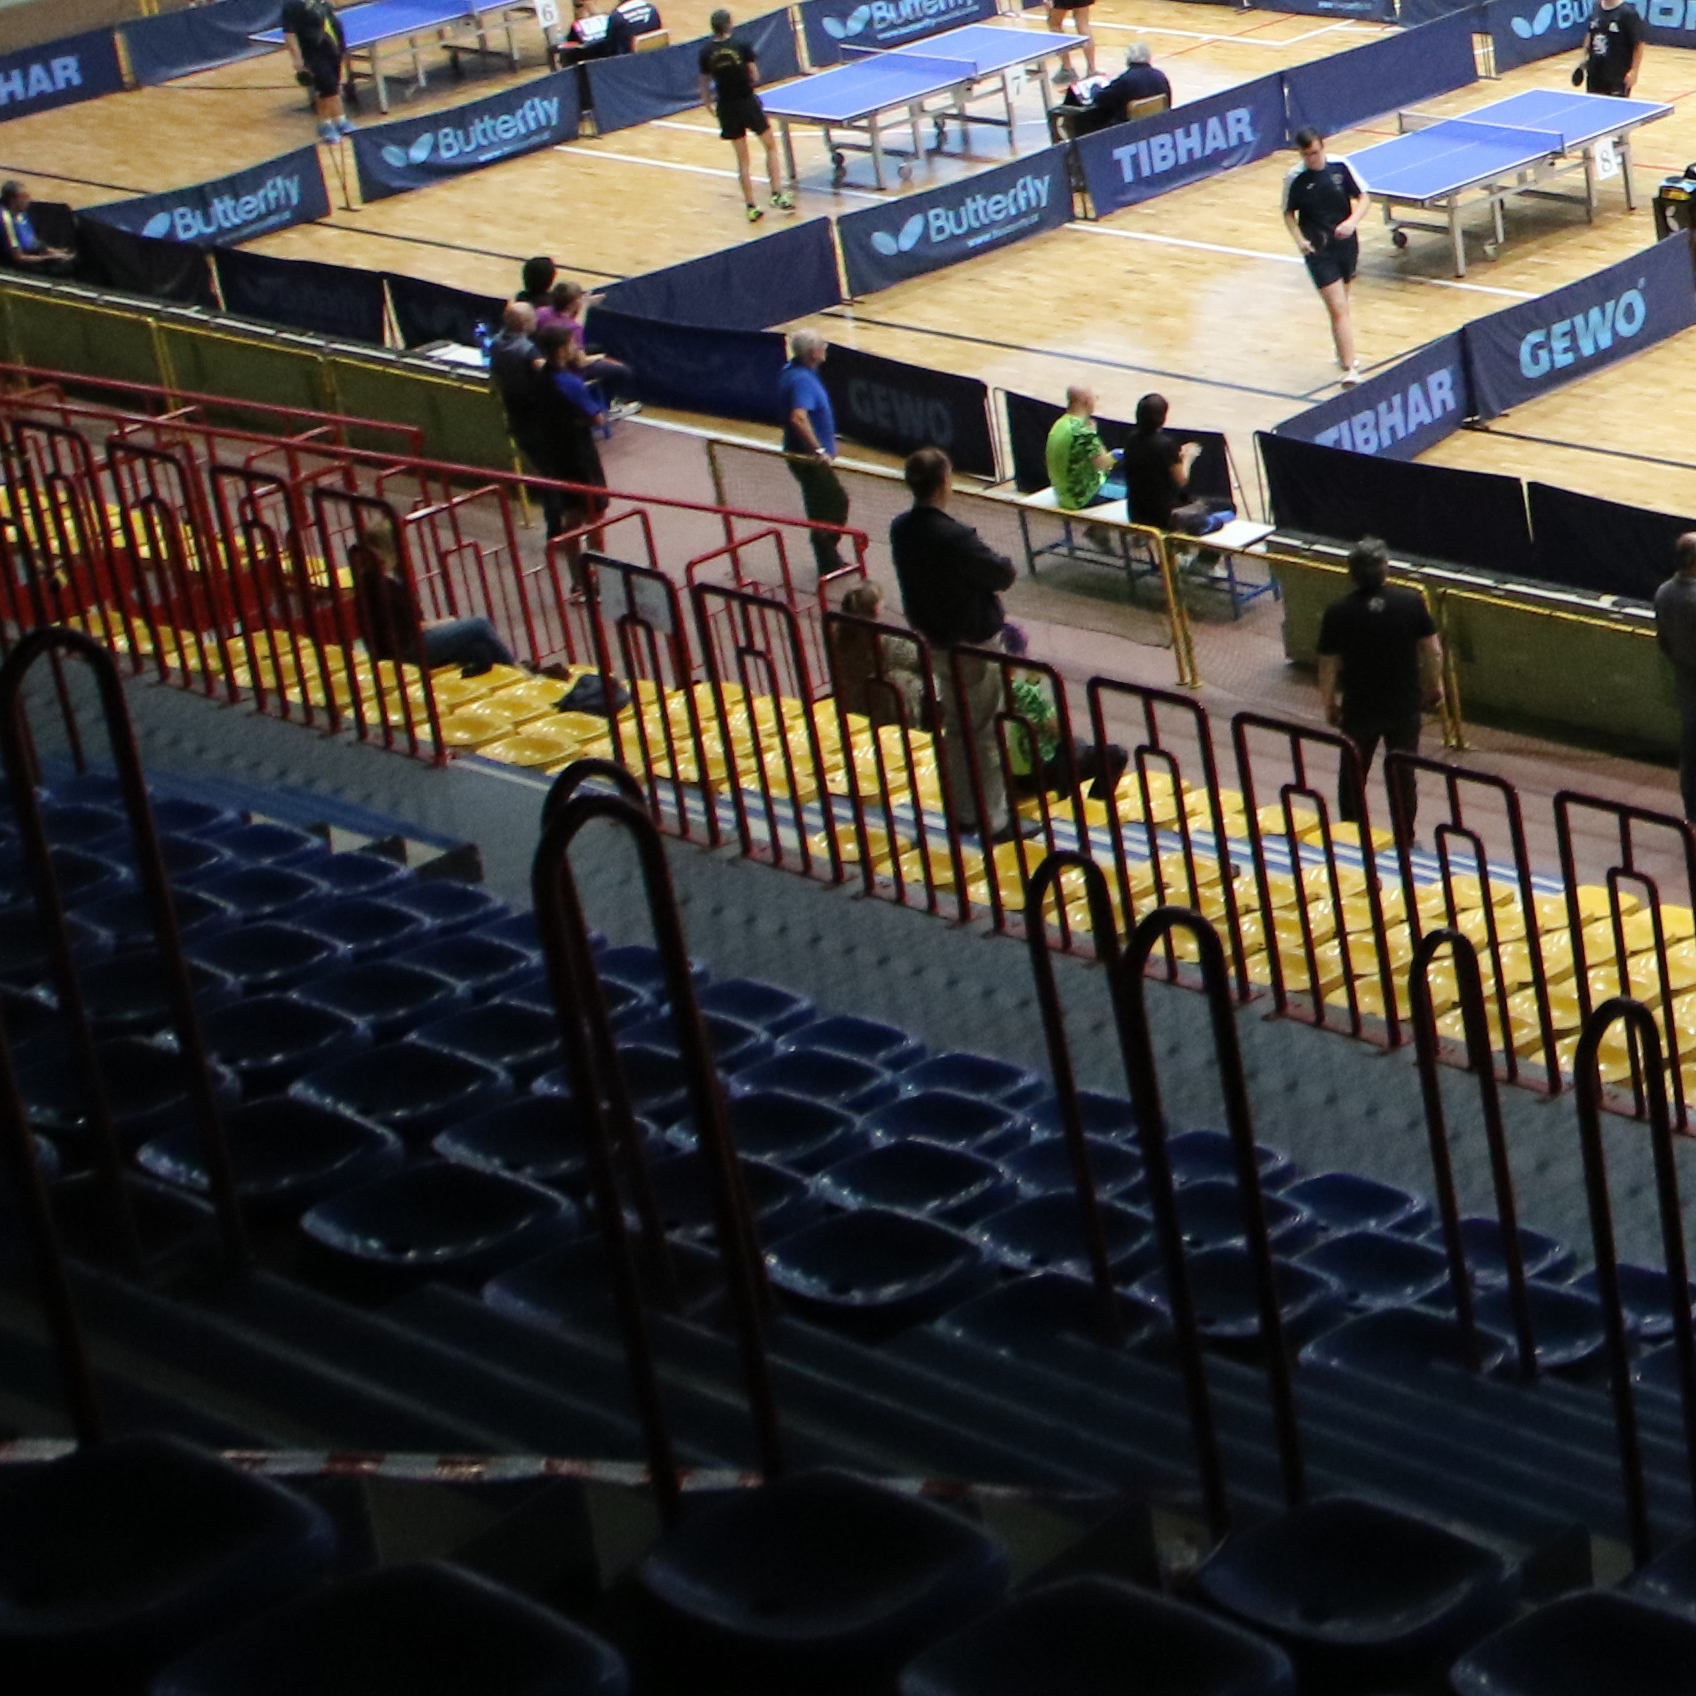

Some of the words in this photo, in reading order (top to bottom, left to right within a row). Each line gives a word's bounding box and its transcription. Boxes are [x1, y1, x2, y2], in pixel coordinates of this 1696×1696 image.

[543, 6, 554, 24] 6
[437, 94, 561, 160] Butterfly
[1112, 108, 1255, 184] TIBHAR
[1600, 150, 1612, 172] 8
[174, 174, 300, 242] Butterfly
[927, 175, 1050, 243] Butterfly
[1519, 288, 1647, 380] GEWO
[1314, 368, 1456, 457] TIBHAR
